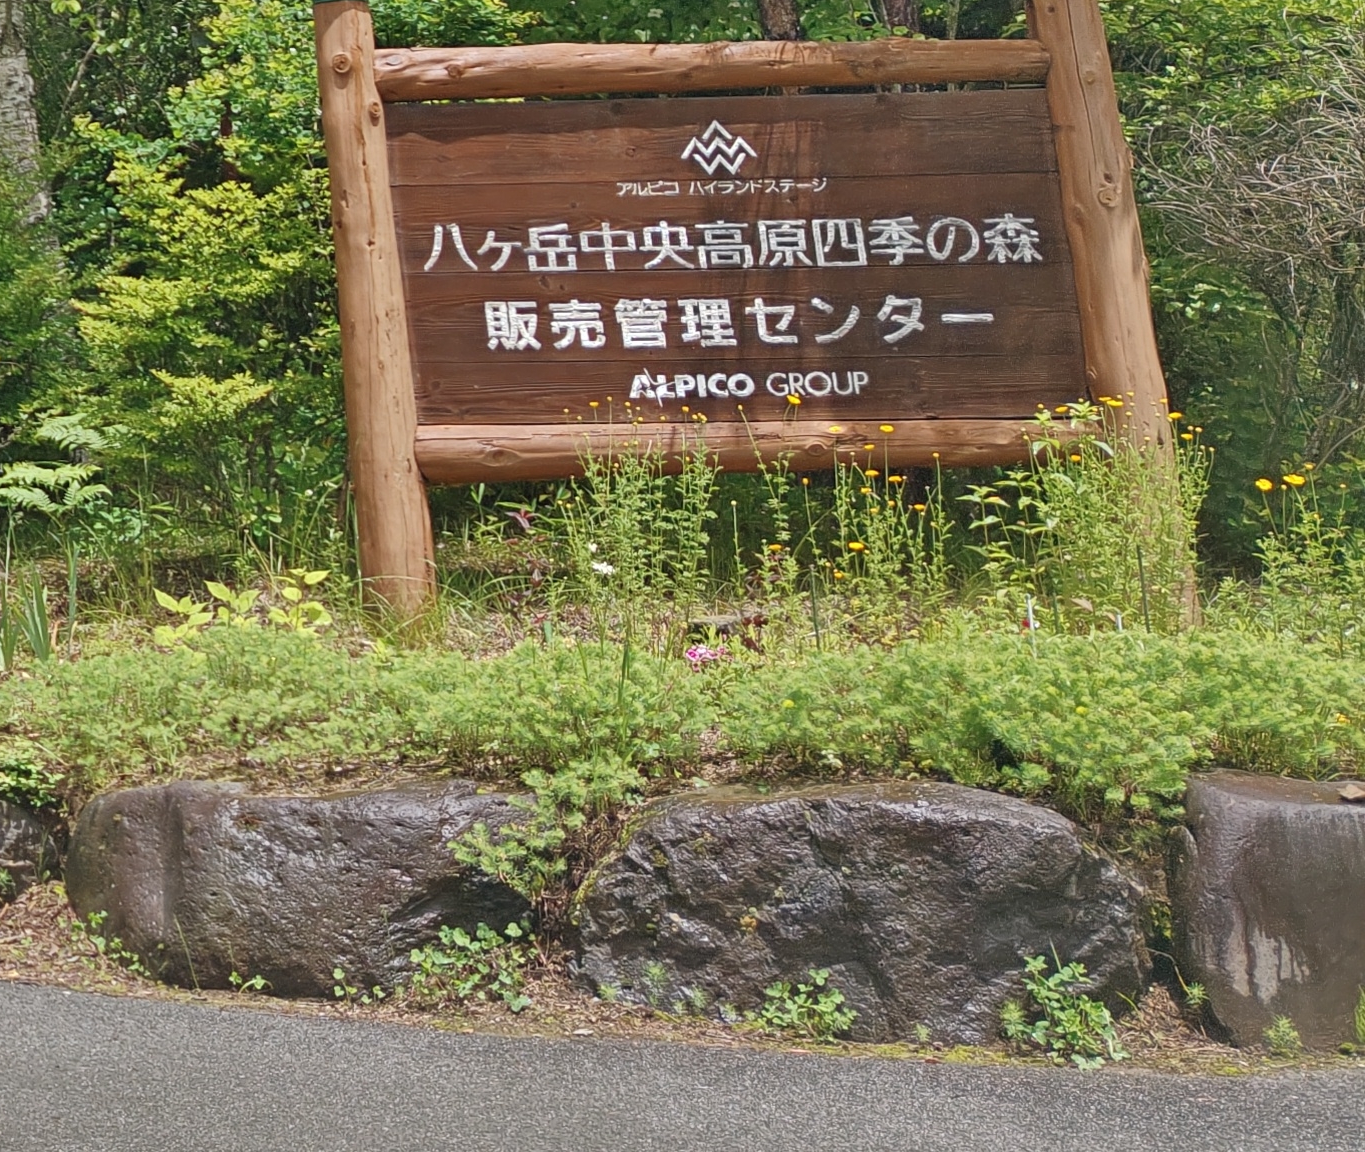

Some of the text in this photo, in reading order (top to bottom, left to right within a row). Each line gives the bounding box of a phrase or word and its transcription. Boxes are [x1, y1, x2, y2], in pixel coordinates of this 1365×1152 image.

[616, 177, 828, 197] アルピコ ハイランドステージ
[483, 294, 995, 351] 販売管理センター
[628, 369, 870, 405] ALPICO GROUP
